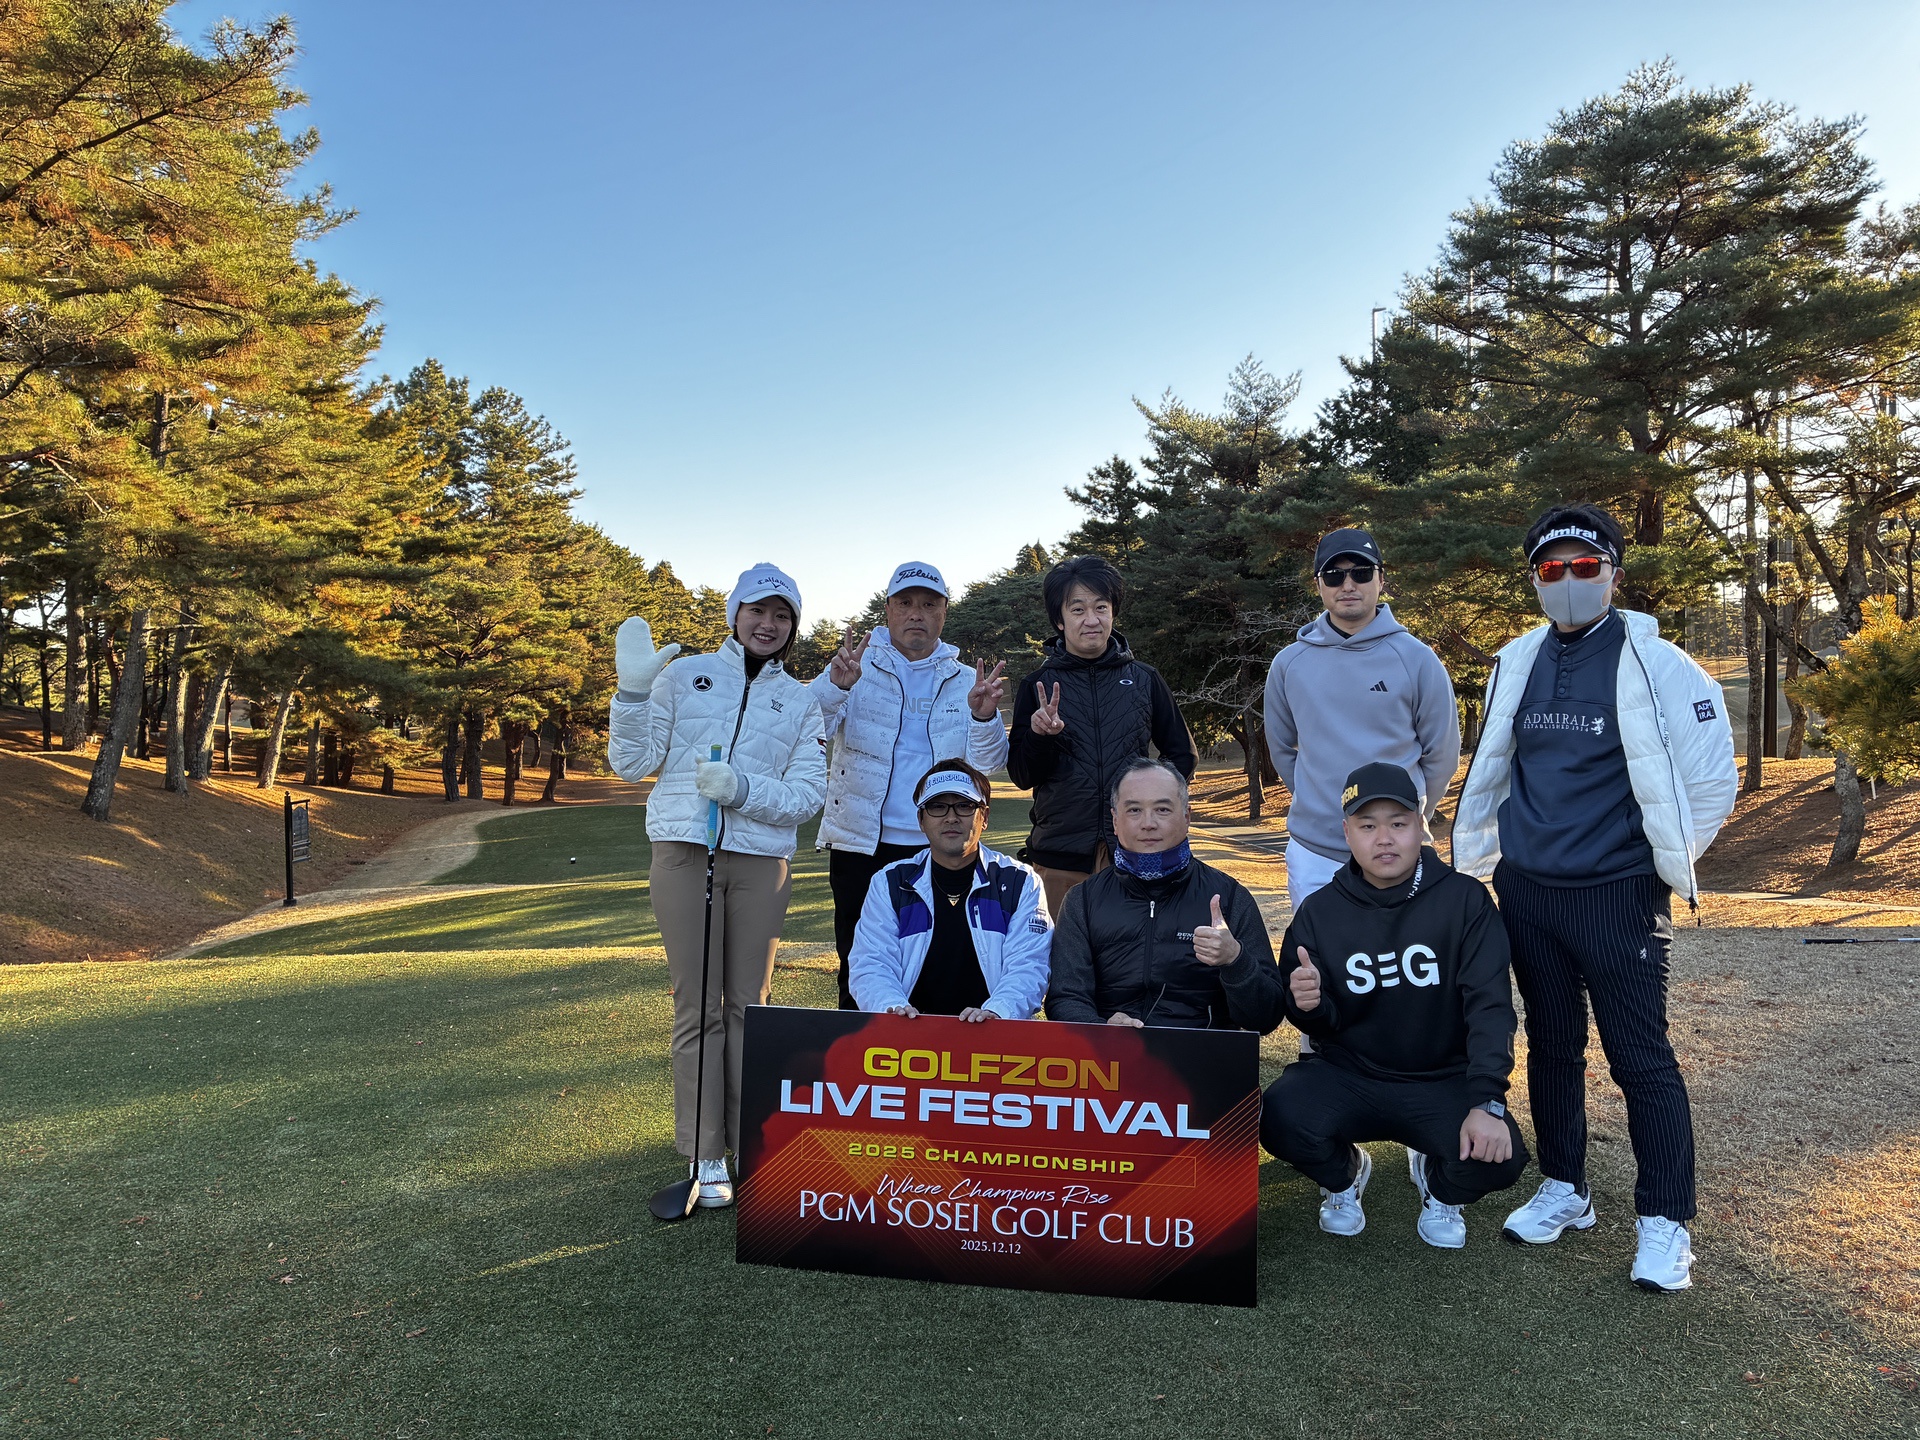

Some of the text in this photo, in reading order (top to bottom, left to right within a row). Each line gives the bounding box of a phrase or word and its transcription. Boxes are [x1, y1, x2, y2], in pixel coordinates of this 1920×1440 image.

[1538, 525, 1597, 544] Admiral
[895, 567, 940, 584] Titleist
[1523, 713, 1590, 727] ADMIRAL
[1345, 943, 1441, 995] SEG
[863, 1046, 1120, 1092] GOLFZON
[780, 1079, 1211, 1140] LIVE FESTIVAL
[848, 1142, 1136, 1174] 2025 CHAMPIONSHIP
[876, 1171, 1114, 1208] Where Champions Rise
[799, 1189, 1196, 1249] PGM SOSEI GOLF CLUB
[960, 1238, 1022, 1255] 2025.12.12
